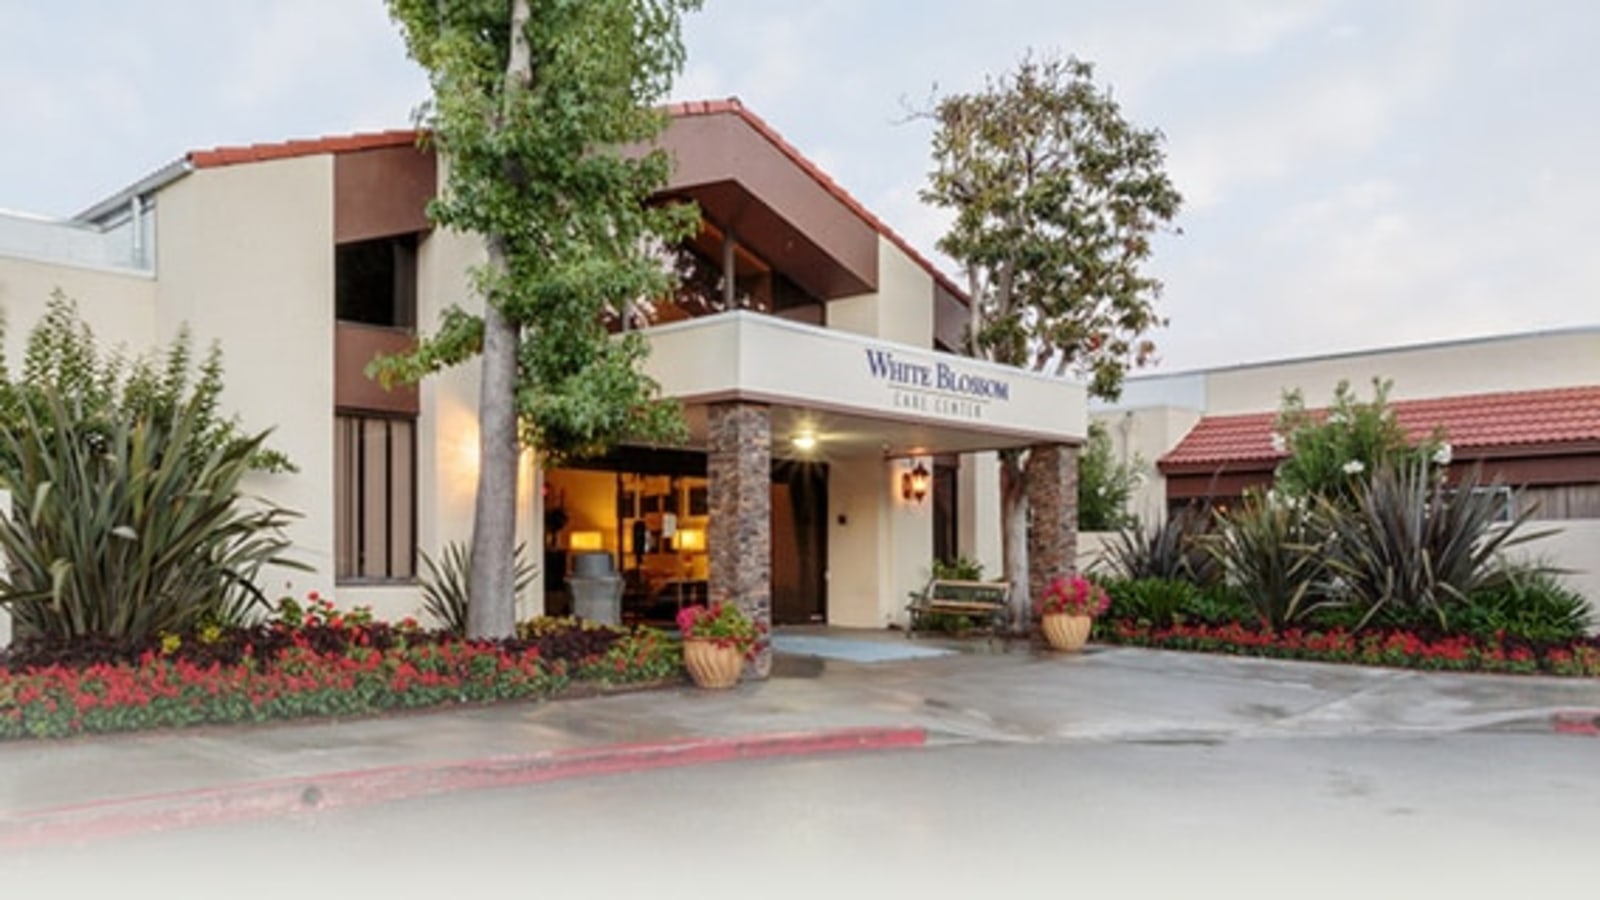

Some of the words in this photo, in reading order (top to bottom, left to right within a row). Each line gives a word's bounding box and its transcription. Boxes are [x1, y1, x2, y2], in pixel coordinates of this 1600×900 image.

[866, 348, 931, 387] WHITE
[935, 362, 1009, 400] BLOSSOM
[895, 391, 927, 411] CARE
